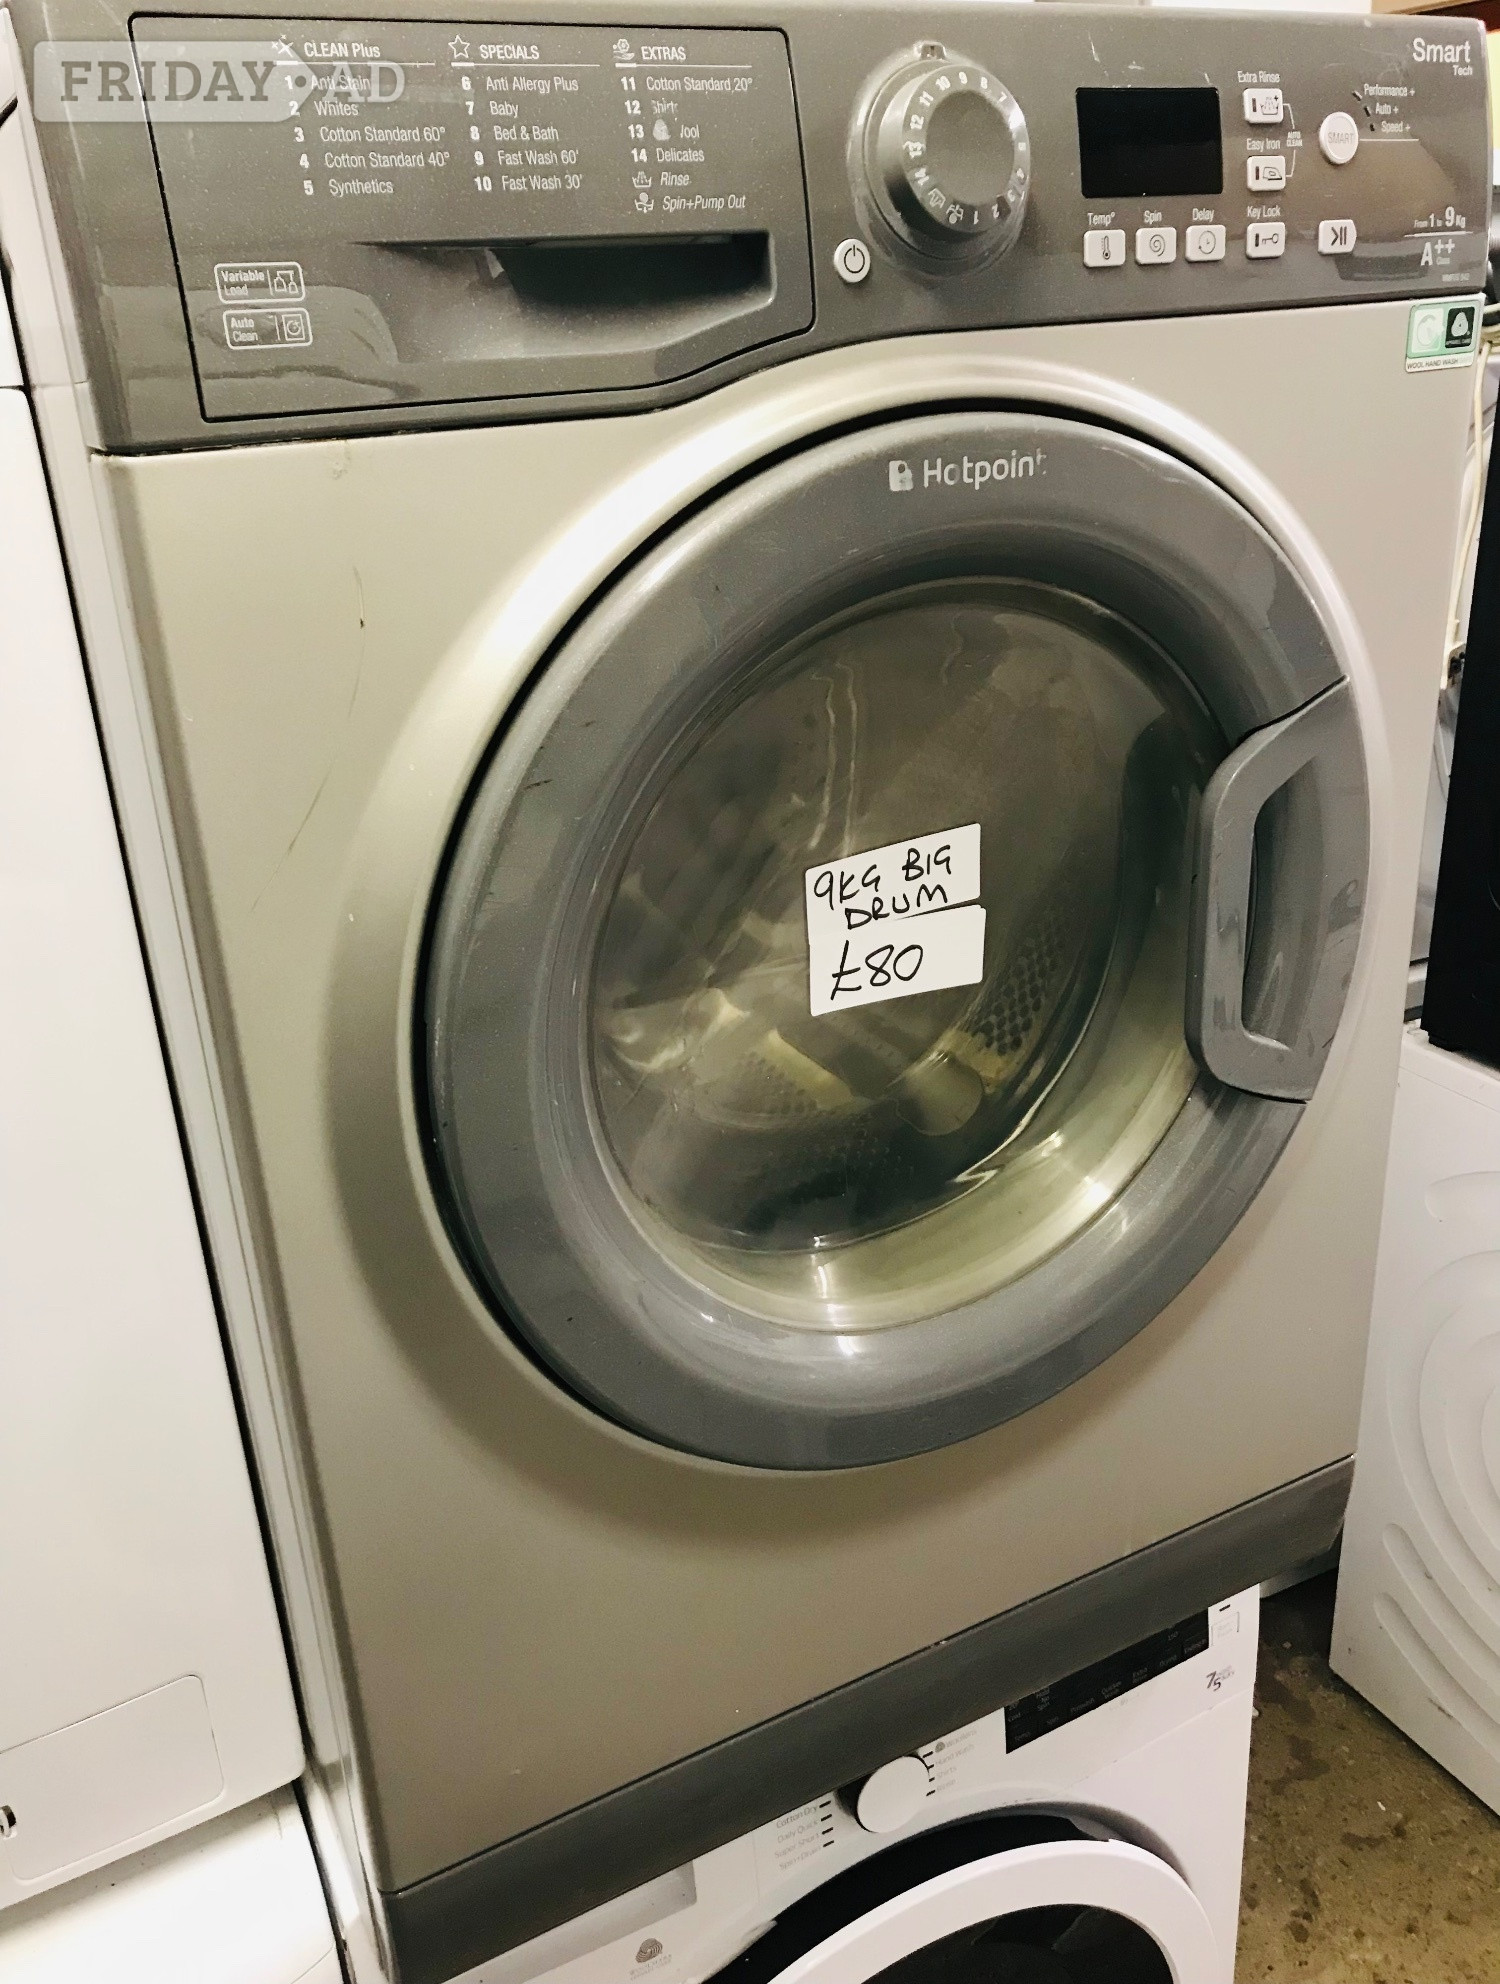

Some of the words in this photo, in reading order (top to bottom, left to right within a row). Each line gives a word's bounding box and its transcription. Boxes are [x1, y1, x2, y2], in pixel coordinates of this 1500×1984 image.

[303, 42, 348, 58] CLEAN
[351, 42, 381, 57] Plus
[479, 45, 540, 60] SPECIALS
[641, 46, 686, 61] EXTRAS
[1412, 37, 1471, 64] Smart
[958, 71, 968, 85] 9
[1237, 71, 1256, 84] Extra
[1258, 71, 1280, 84] Rinse
[1453, 65, 1473, 76] Tech
[284, 75, 294, 90] 1
[311, 74, 335, 90] Anti
[339, 75, 371, 90] Stain
[461, 77, 471, 90] 6
[486, 76, 508, 91] Anti
[512, 76, 551, 94] Allergy
[553, 76, 579, 91] Plus
[621, 76, 636, 91] 11
[646, 76, 681, 91] Cotton
[684, 76, 731, 91] Standard
[733, 76, 753, 91] 20°
[935, 75, 950, 91] 10
[1364, 84, 1407, 97] Performance
[289, 101, 300, 117] 2
[313, 101, 359, 117] Whites
[465, 101, 475, 115] 7
[489, 101, 519, 118] Baby
[624, 100, 641, 115] 12
[1375, 103, 1391, 115] Auto
[294, 128, 304, 142] 3
[320, 127, 362, 142] Cotton
[364, 126, 420, 142] Standard
[422, 126, 446, 141] 60°
[470, 127, 480, 141] 8
[493, 126, 517, 141] Bed
[519, 127, 530, 140] &
[531, 126, 559, 141] Bath
[628, 124, 645, 140] 13
[1381, 121, 1403, 133] Speed
[1246, 138, 1264, 151] Easy
[1265, 138, 1281, 149] Iron
[1327, 132, 1355, 144] SMART
[300, 154, 310, 168] 4
[325, 152, 367, 168] Cotton
[370, 152, 424, 168] Standard
[427, 151, 451, 167] 40°
[474, 152, 484, 166] 9
[498, 151, 523, 165] Fast
[526, 151, 558, 165] Wash
[631, 148, 648, 163] 14
[656, 148, 705, 163] Delicates
[474, 176, 492, 192] 10
[502, 176, 527, 190] Fast
[529, 175, 561, 190] Wash
[660, 172, 690, 186] Rinse
[303, 180, 314, 195] 5
[328, 179, 394, 197] Synthetics
[662, 196, 725, 212] Spin+Pump
[727, 195, 746, 210] Out
[1143, 209, 1162, 224] Spin
[1192, 208, 1214, 222] Delay
[1246, 205, 1262, 219] Key
[1262, 205, 1281, 217] Lock
[1429, 212, 1435, 228] 1
[1445, 206, 1455, 228] 9
[1420, 239, 1456, 267] A++
[220, 269, 265, 283] Variable
[223, 283, 249, 296] Load
[230, 317, 255, 329] Auto
[232, 331, 259, 342] Clean
[1407, 362, 1424, 370] WOOL
[1425, 359, 1441, 367] HAND
[814, 864, 881, 911] 9KG
[901, 844, 952, 882] BIG
[844, 883, 948, 930] DRUM
[830, 939, 924, 1001] £80
